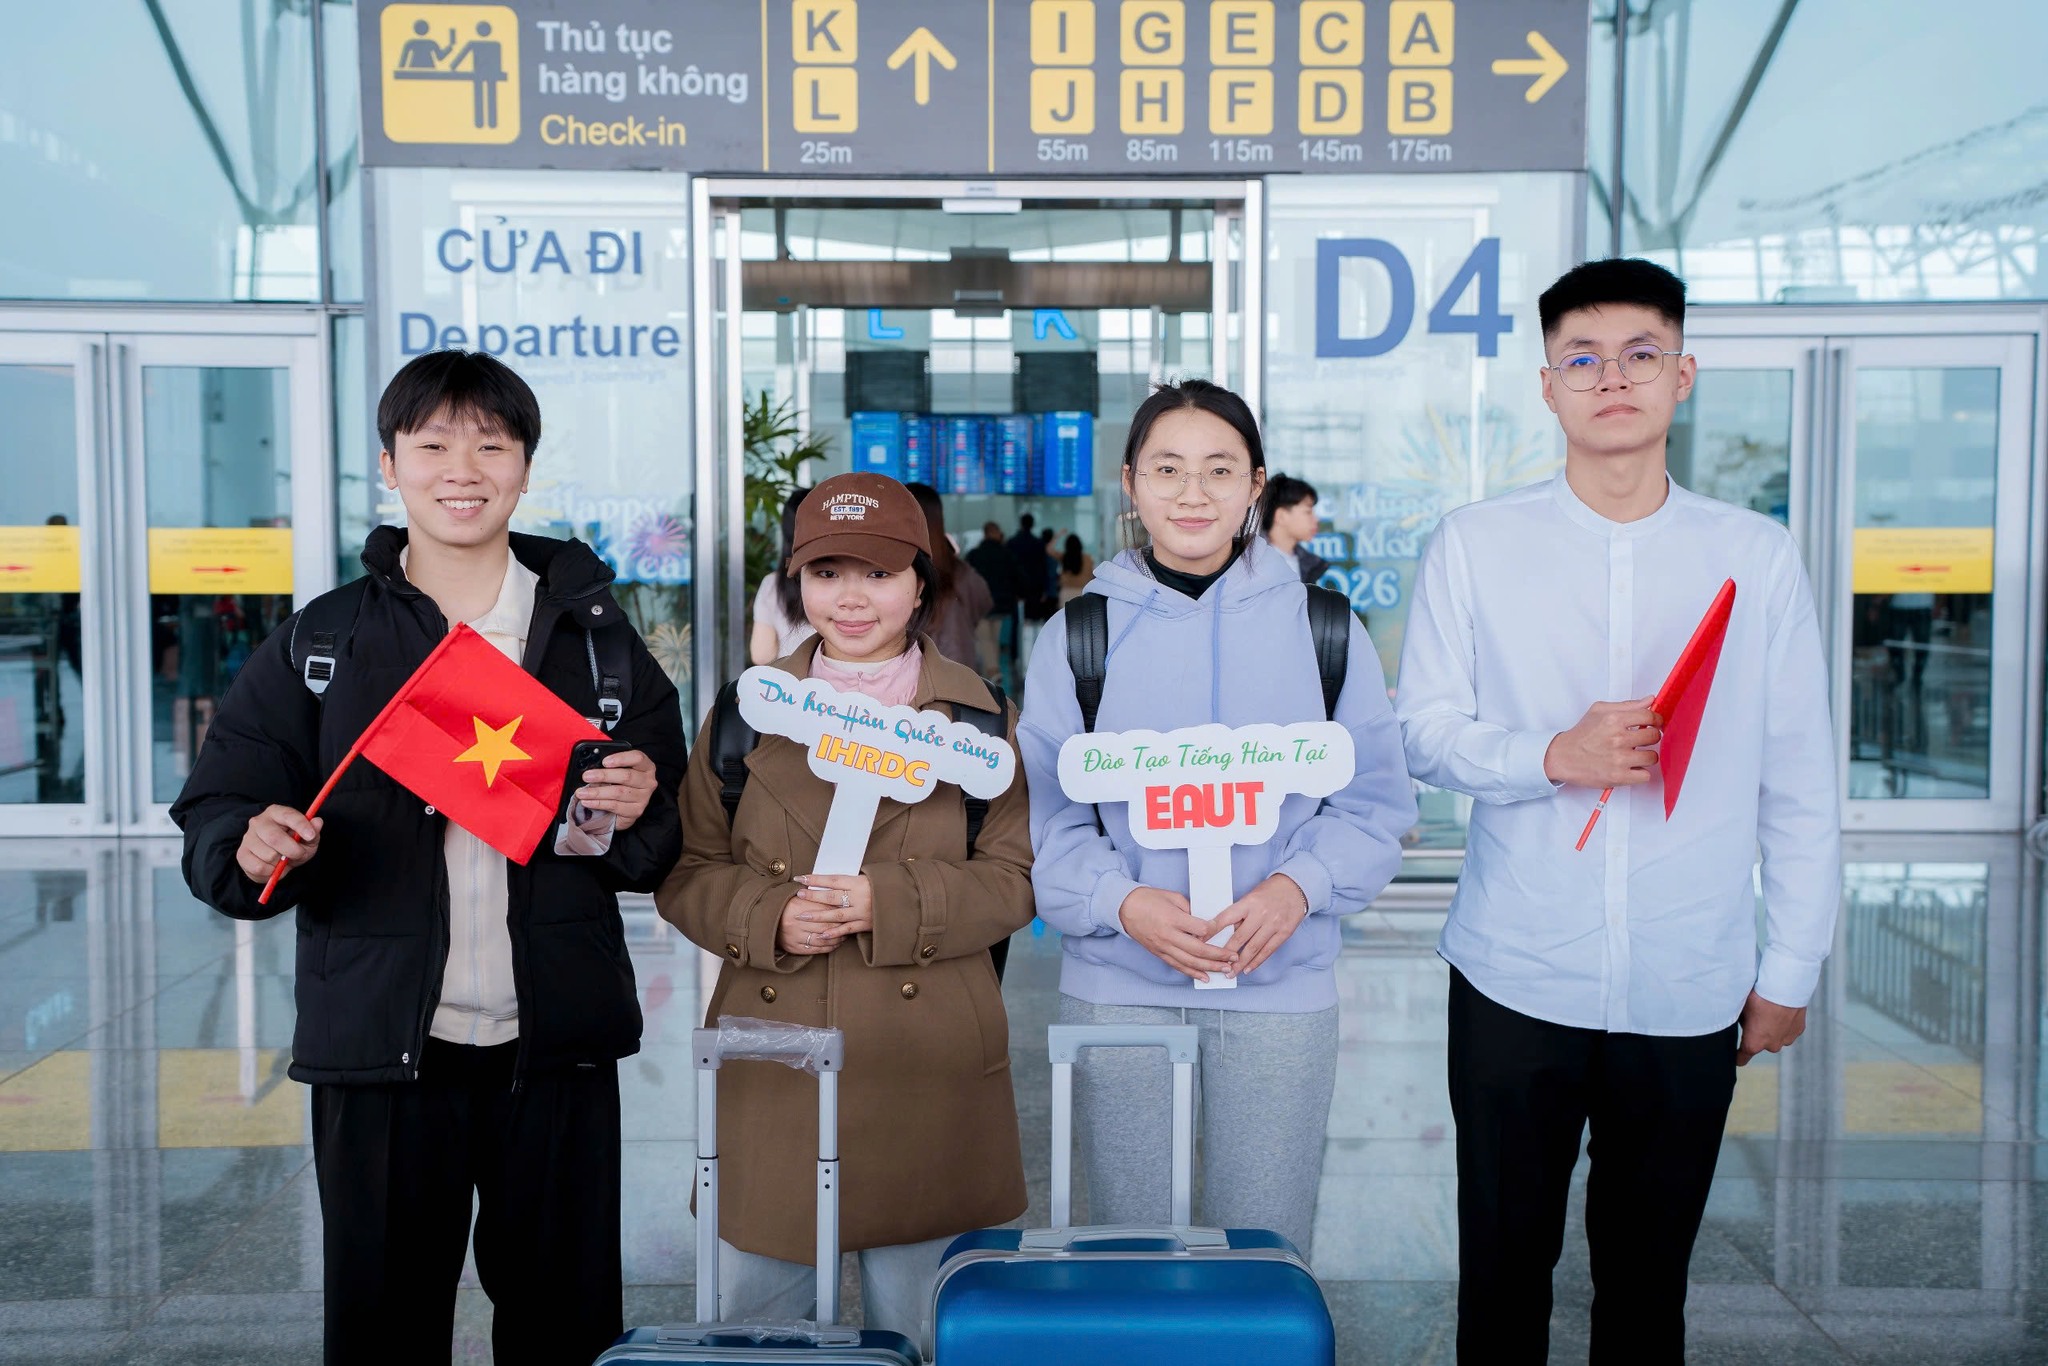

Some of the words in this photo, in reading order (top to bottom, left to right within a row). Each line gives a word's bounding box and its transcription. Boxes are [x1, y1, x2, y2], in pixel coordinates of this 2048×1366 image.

[537, 19, 606, 52] Thủ
[616, 26, 673, 60] tục
[806, 10, 842, 52] K
[1059, 11, 1067, 54] I
[1133, 11, 1172, 54] G
[1226, 12, 1257, 54] E
[1314, 11, 1349, 54] C
[1402, 12, 1440, 53] A
[538, 62, 628, 103] hàng
[638, 64, 749, 104] không
[811, 79, 841, 121] L
[1050, 80, 1076, 122] J
[1135, 81, 1169, 122] H
[1227, 81, 1256, 122] F
[1313, 81, 1348, 122] D
[1403, 81, 1437, 122] B
[540, 113, 687, 146] Check-in
[1037, 139, 1089, 161] 55m
[1126, 139, 1178, 161] 85m
[1209, 139, 1274, 162] 115m
[1299, 139, 1363, 162] 145m
[1388, 139, 1452, 162] 175m
[800, 140, 853, 164] 25m
[437, 215, 571, 274] CỬA
[585, 230, 643, 274] ĐI
[1315, 237, 1514, 358] D4
[399, 311, 681, 358] Departure
[821, 493, 879, 511] HAMPTONS
[1316, 568, 1399, 608] 026
[758, 678, 797, 703] Du
[803, 691, 838, 717] học
[838, 704, 888, 733] Hàn
[894, 718, 946, 747] Quốc
[952, 736, 1000, 770] cùng
[815, 734, 931, 787] IHRDC
[1083, 748, 1126, 772] Đào
[1132, 746, 1172, 771] Tạo
[1177, 743, 1235, 771] Tiếng
[1241, 740, 1286, 765] Hàn
[1292, 739, 1329, 765] Tại
[1145, 781, 1265, 831] EAUT
